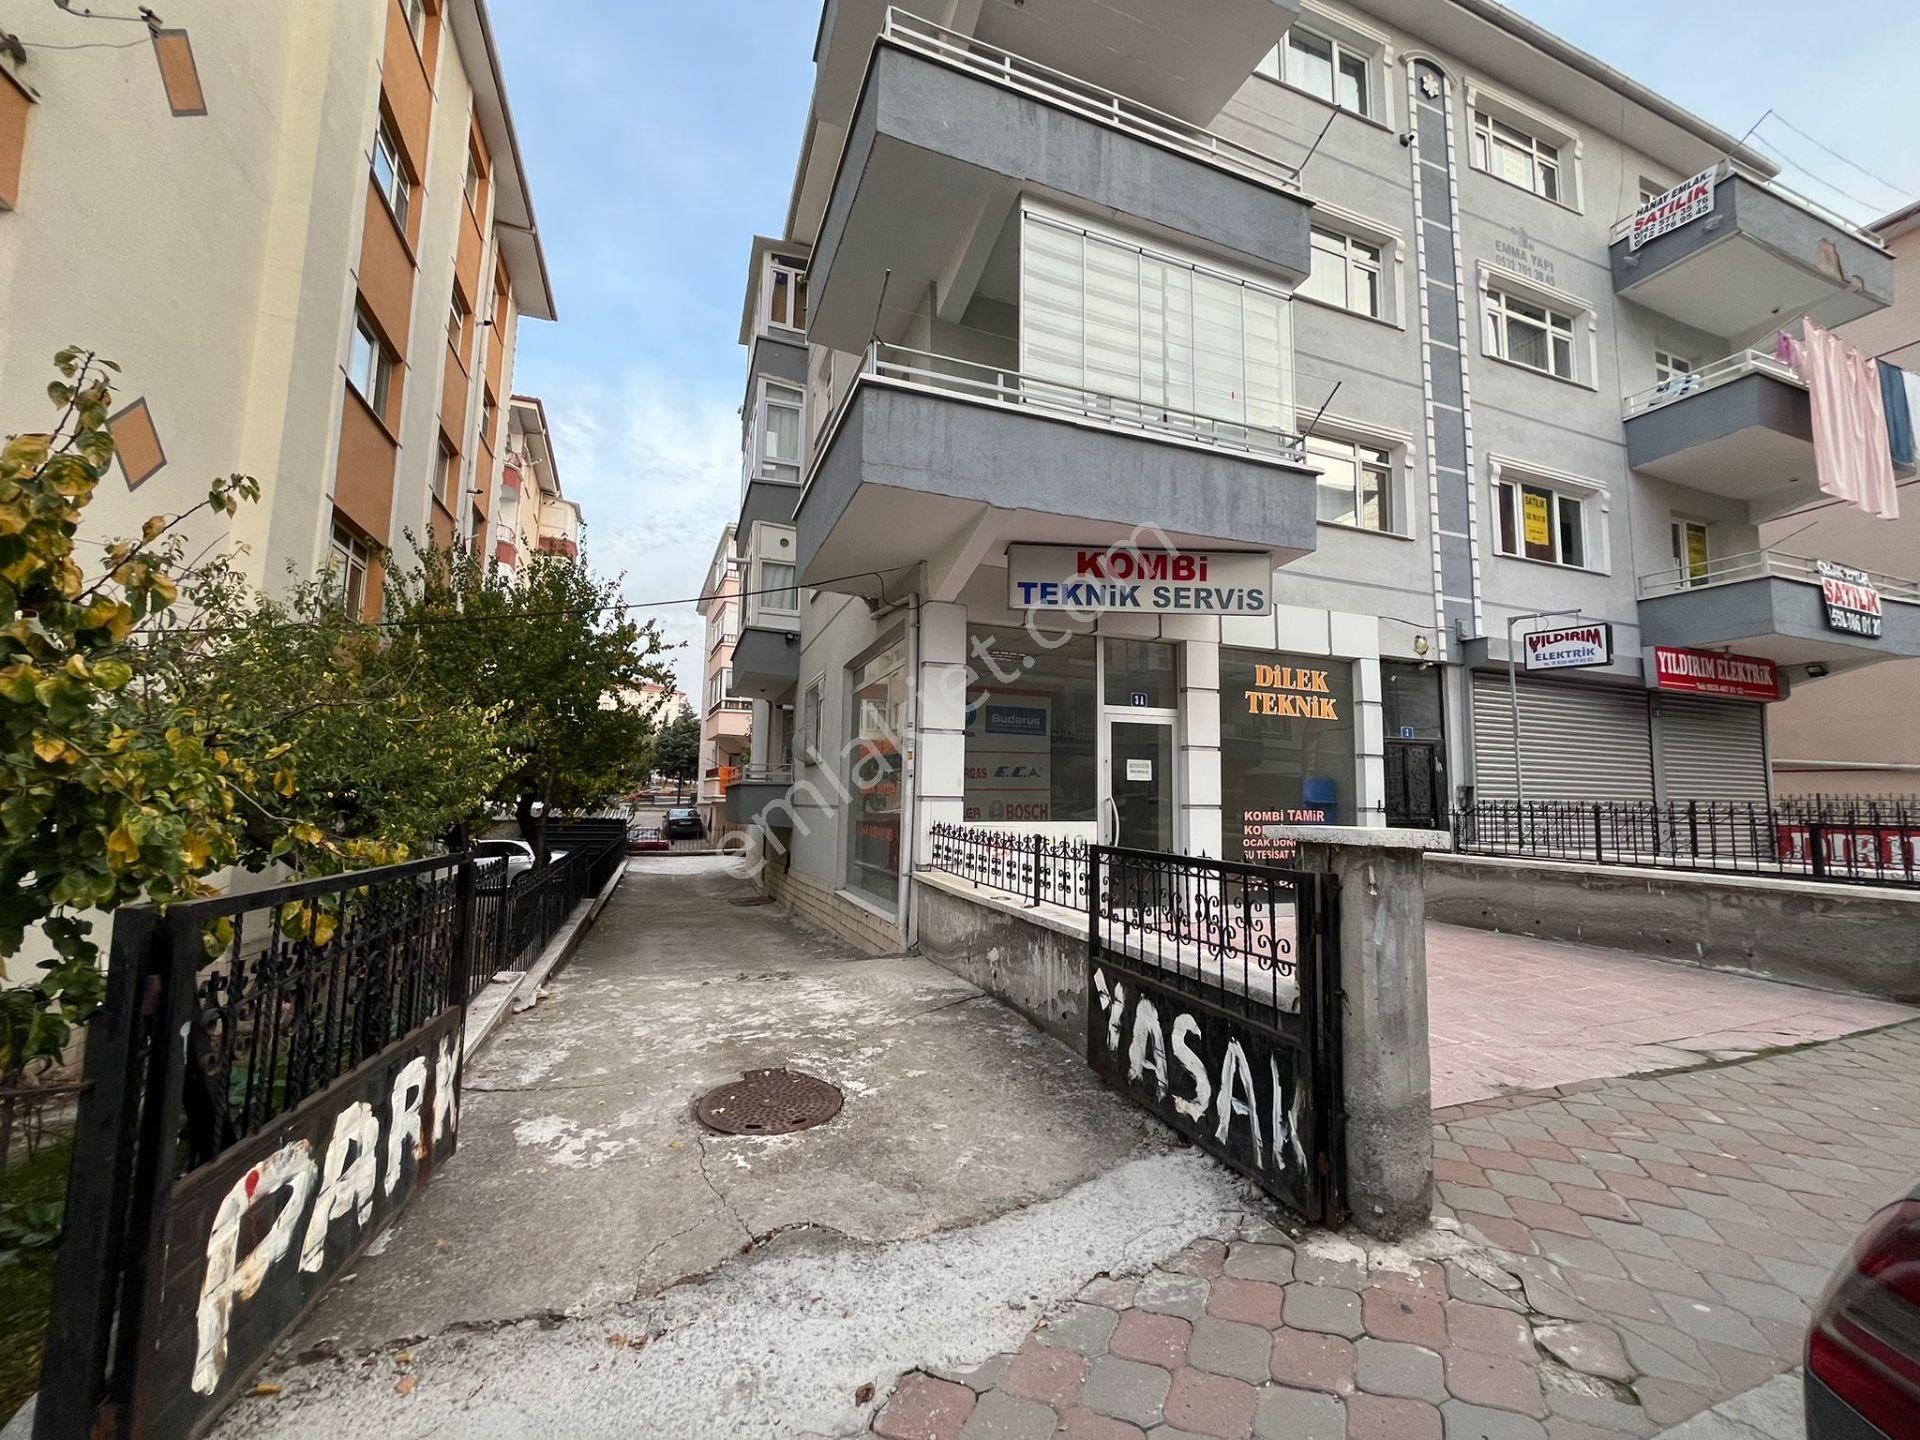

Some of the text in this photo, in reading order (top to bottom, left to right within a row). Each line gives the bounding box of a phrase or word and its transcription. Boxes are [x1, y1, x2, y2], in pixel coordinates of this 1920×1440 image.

[1672, 172, 1707, 198] EMLAK
[1633, 181, 1710, 232] SATILIK
[1495, 240, 1554, 273] EMMA YAPI
[1824, 578, 1880, 614] SATILIK
[1528, 628, 1603, 653] YILDIRIM
[1657, 651, 1716, 679] YILDIRIM
[992, 712, 1041, 726] Buderus
[965, 767, 988, 779] RGAS
[1006, 803, 1050, 820] BOSCH
[1244, 810, 1284, 822] KOMBİ
[1244, 825, 1264, 835] KO
[1243, 839, 1270, 847] OCAK
[191, 1030, 461, 1396] PARK
